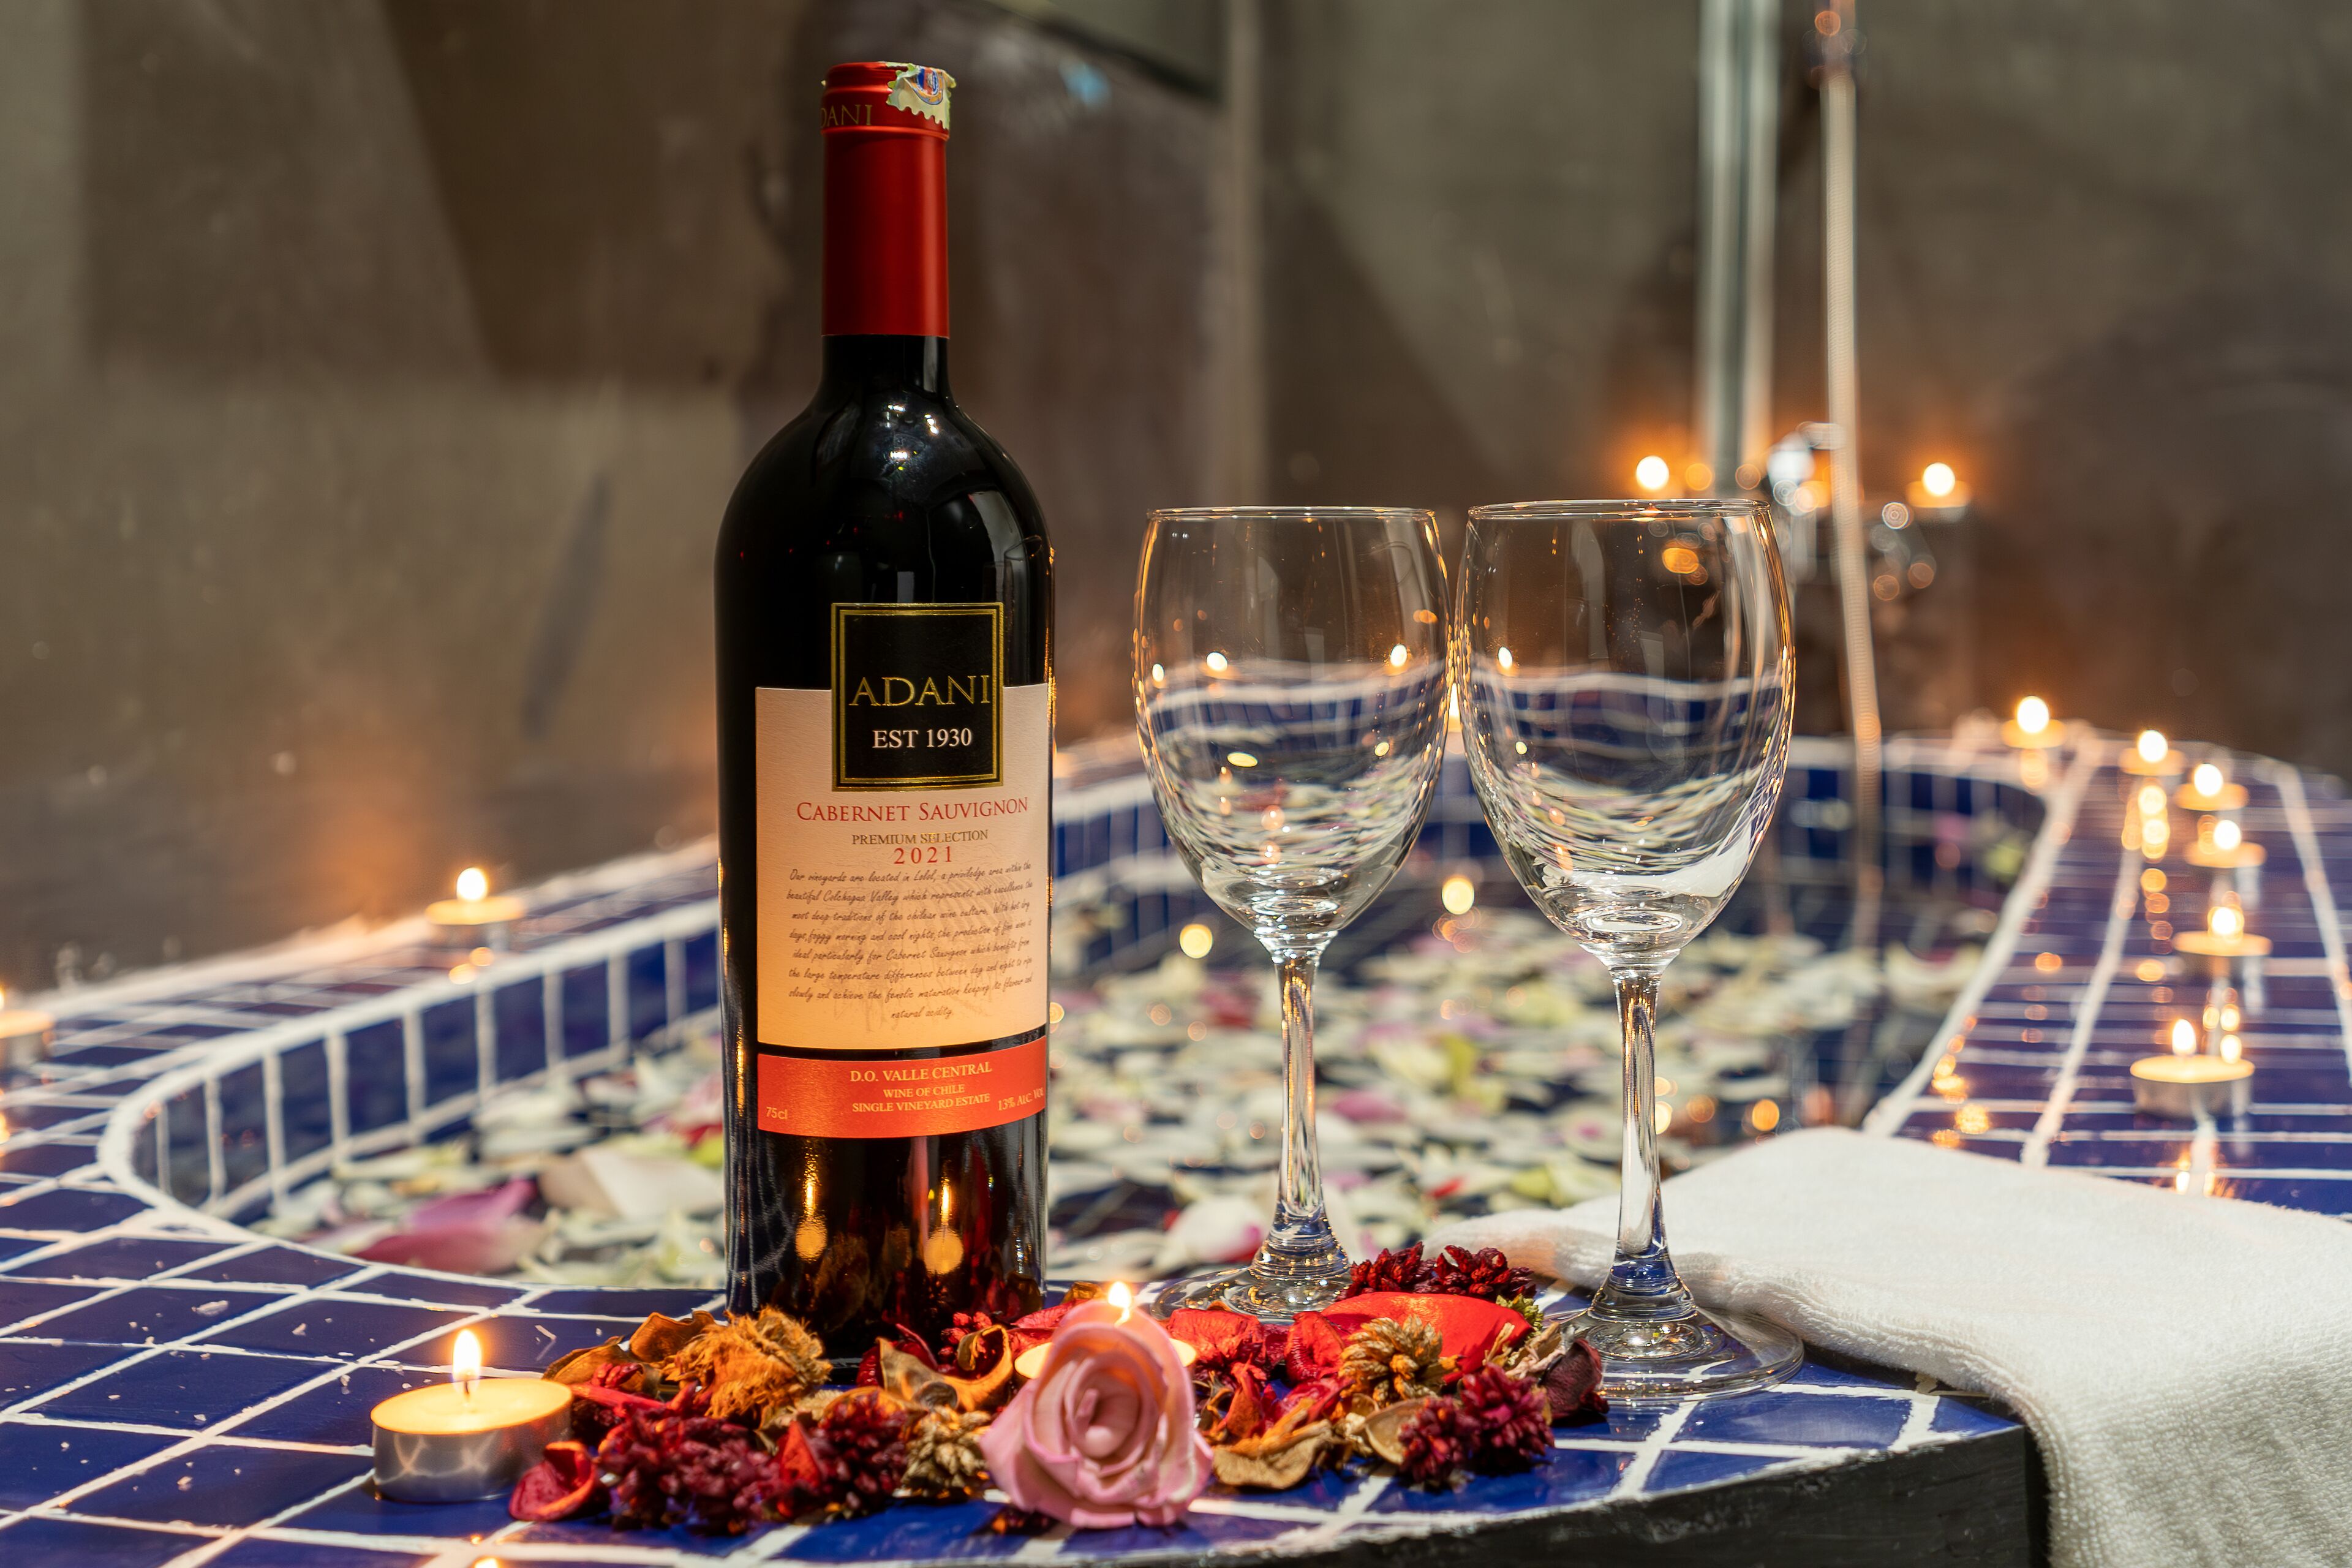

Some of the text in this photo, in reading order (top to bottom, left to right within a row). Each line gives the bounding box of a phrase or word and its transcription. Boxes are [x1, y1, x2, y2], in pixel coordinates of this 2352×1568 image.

[849, 675, 990, 706] ADANI
[872, 728, 972, 748] EST 1930
[797, 797, 1028, 822] CABERNET SAUVIGNON
[853, 829, 988, 845] PREMIUM SELECTION
[894, 846, 952, 864] 2021
[790, 869, 805, 880] Our
[808, 872, 846, 886] vineyards
[868, 871, 901, 882] located
[902, 873, 910, 882] in
[786, 889, 822, 905] beautiful
[870, 890, 899, 906] Valley
[903, 889, 927, 900] which
[931, 889, 974, 904] represents
[976, 884, 991, 896] with
[792, 911, 809, 919] most
[812, 910, 829, 925] deep
[834, 911, 873, 921] traditions
[876, 910, 887, 925] of
[889, 911, 903, 921] the
[940, 910, 957, 918] wine
[835, 932, 866, 945] morning
[870, 930, 886, 941] and
[888, 929, 908, 940] cool
[952, 925, 990, 941] production
[793, 948, 813, 959] ideal
[811, 949, 864, 965] particularly
[867, 949, 882, 965] for
[886, 949, 927, 960] Cabernet
[930, 946, 967, 961] Sauvignon
[970, 942, 990, 954] which
[789, 967, 800, 978] the
[804, 968, 824, 983] large
[829, 971, 880, 984] temperature
[884, 968, 933, 983] differences
[936, 967, 968, 977] between
[970, 963, 983, 978] day
[986, 960, 1000, 972] and
[789, 986, 813, 1003] slowly
[816, 989, 832, 999] and
[833, 989, 864, 1000] achieve
[867, 989, 882, 999] the
[918, 987, 960, 998] maturation
[963, 983, 990, 997] keeping
[891, 1006, 925, 1018] natural
[850, 1061, 992, 1082] D.O. VALLE CENTRAL
[883, 1084, 965, 1098] WINE OF CHILE
[766, 1106, 788, 1120] 75cl
[853, 1093, 990, 1113] SINGLE VINEYARD ESTATE
[998, 1096, 1016, 1111] 13%
